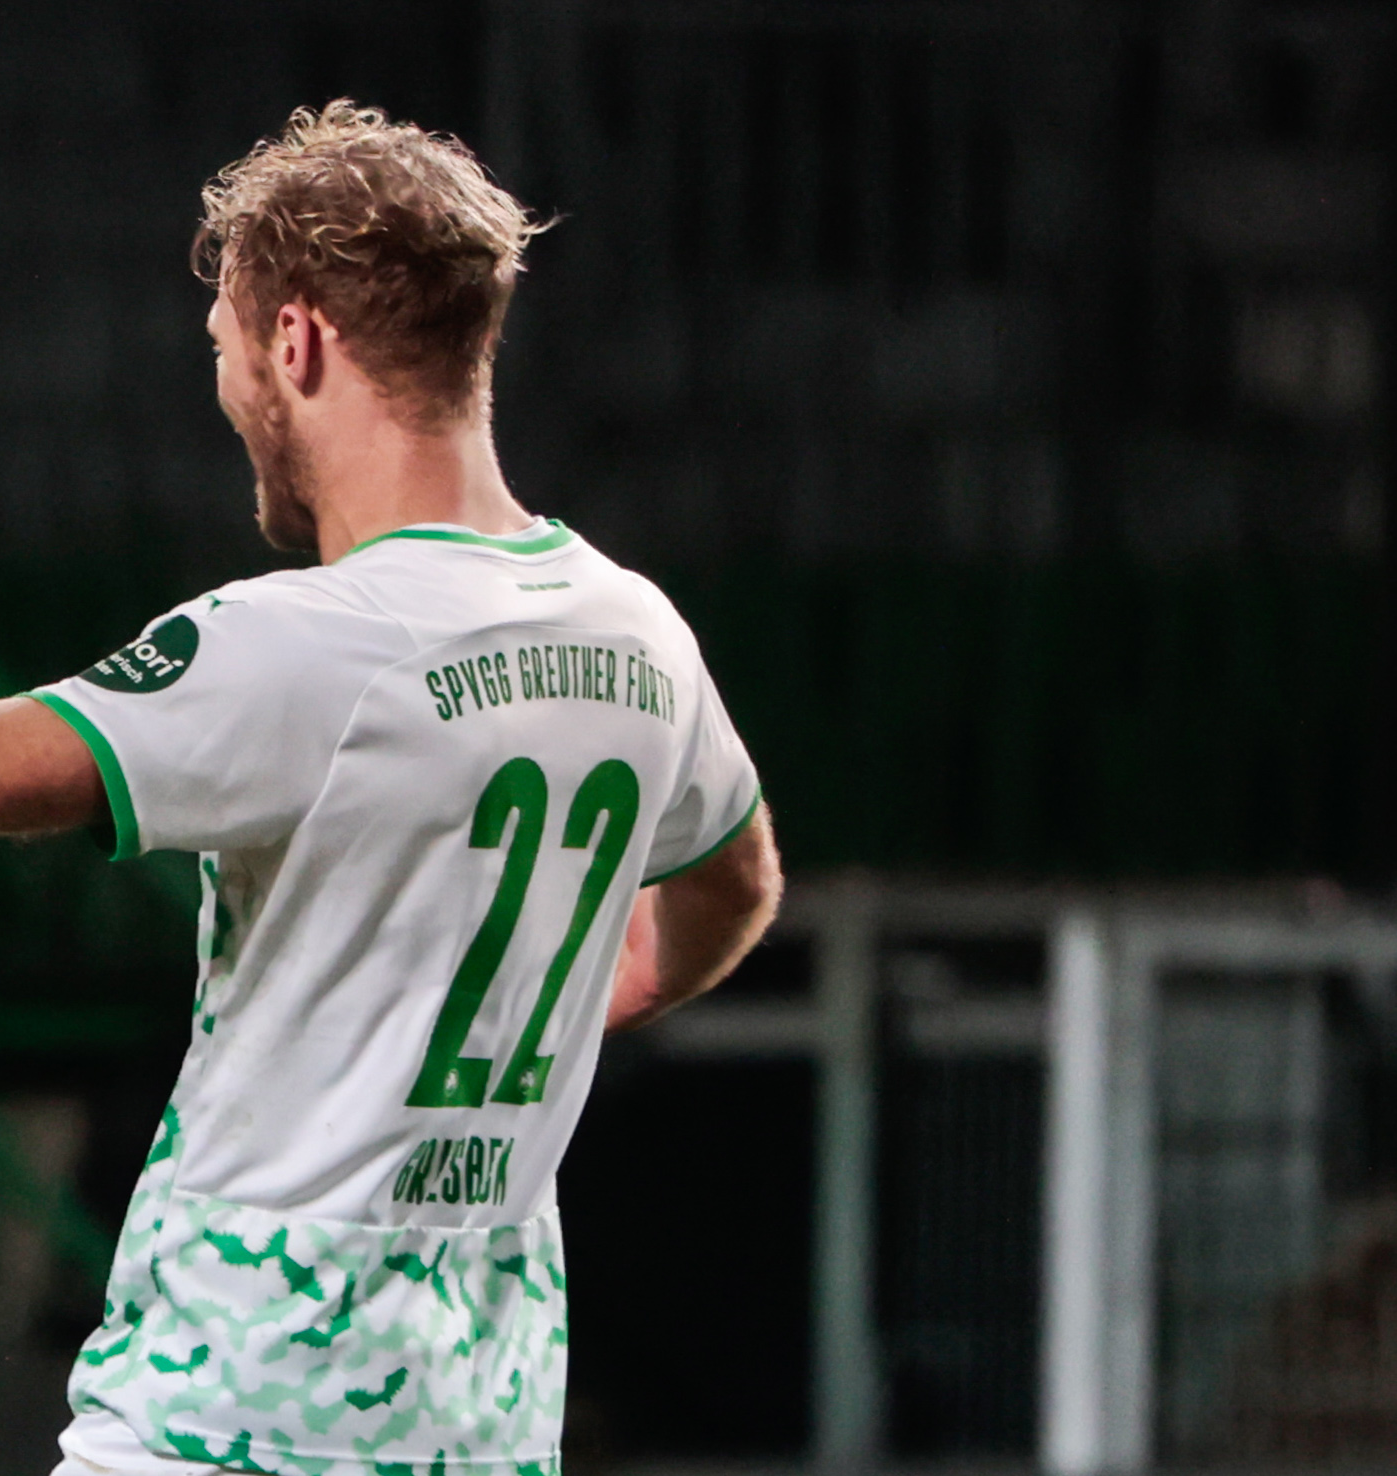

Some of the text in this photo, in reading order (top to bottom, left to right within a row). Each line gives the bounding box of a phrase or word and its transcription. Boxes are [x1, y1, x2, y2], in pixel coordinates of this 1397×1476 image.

[518, 645, 617, 703] GREUTHER
[625, 648, 675, 728] FÜRTH
[404, 756, 640, 1109] 22
